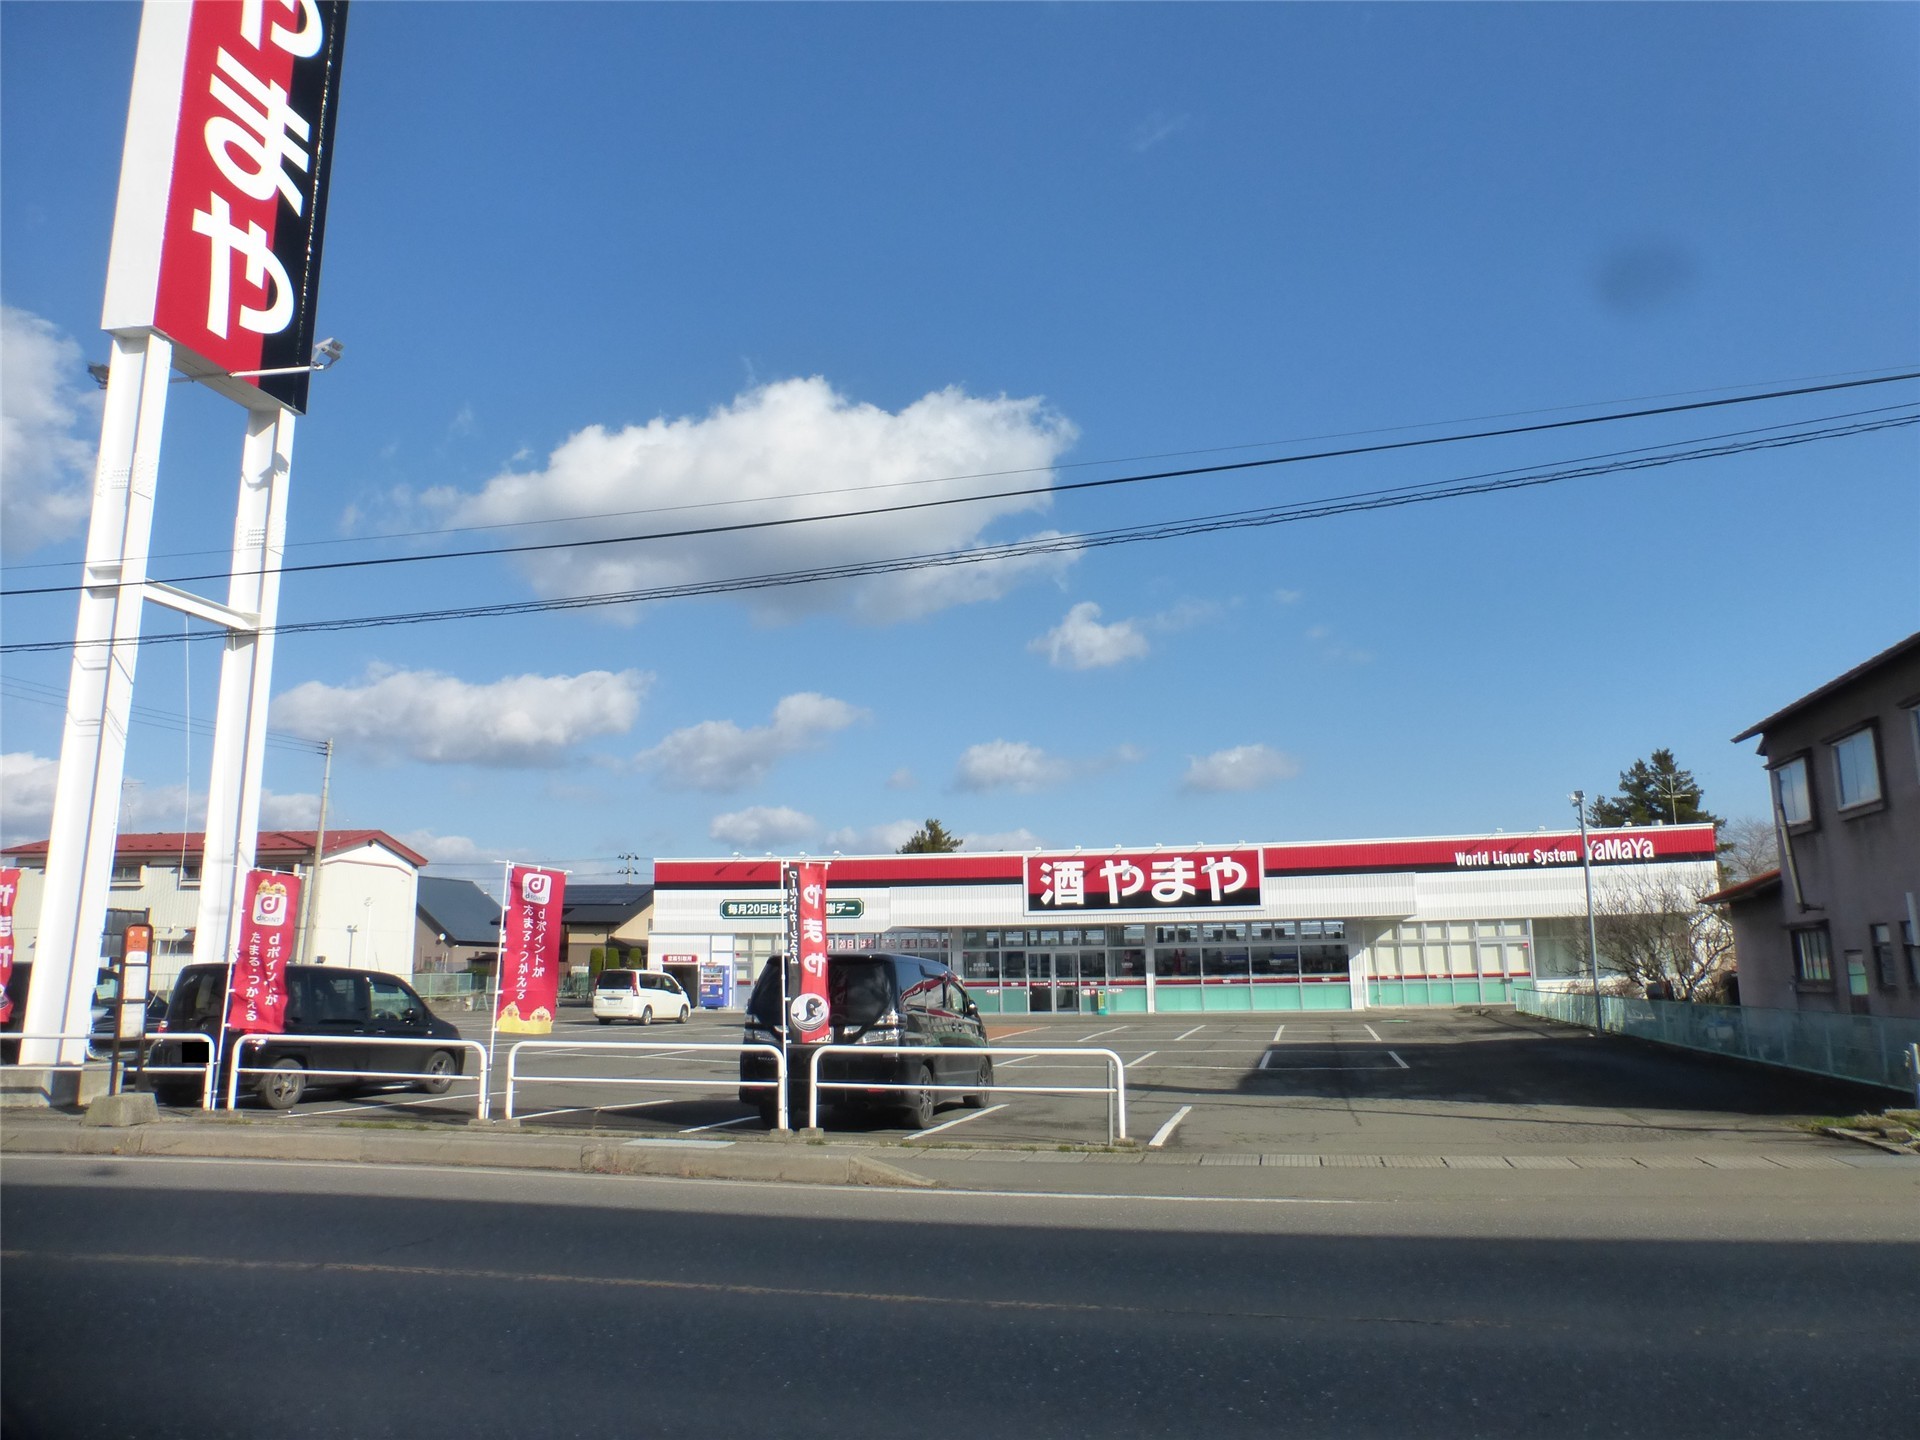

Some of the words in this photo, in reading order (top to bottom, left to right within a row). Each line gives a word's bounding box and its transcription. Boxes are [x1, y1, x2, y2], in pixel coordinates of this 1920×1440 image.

[1039, 860, 1085, 905] 酒
[1100, 856, 1248, 904] やまや
[1455, 851, 1489, 866] World
[1493, 850, 1529, 866] Liquor
[1533, 848, 1577, 865] System
[532, 908, 547, 978] dポイントが
